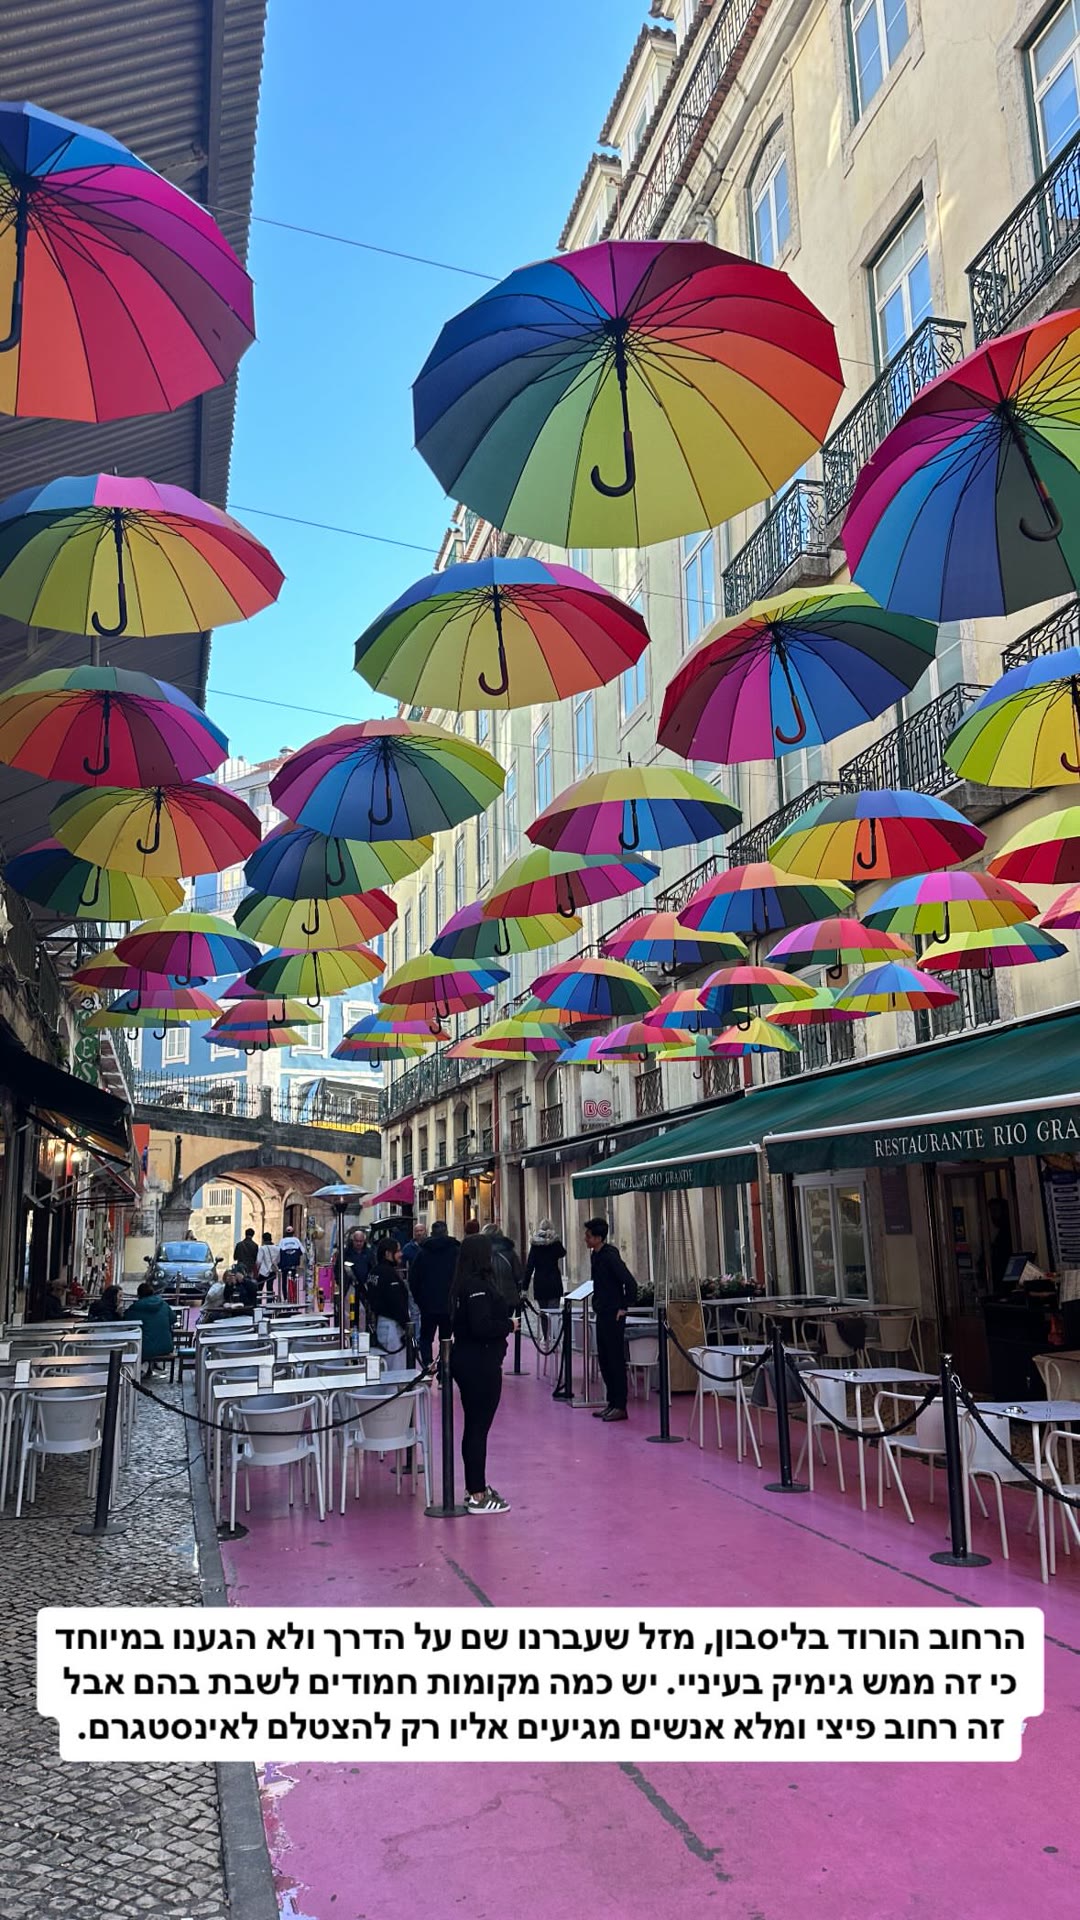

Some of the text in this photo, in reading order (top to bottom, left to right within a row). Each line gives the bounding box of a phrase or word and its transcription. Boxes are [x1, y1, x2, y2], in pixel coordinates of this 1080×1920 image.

[584, 1099, 612, 1118] BC
[874, 1117, 1080, 1157] RESTAURANTE RIO GRA
[649, 1172, 662, 1186] RIO
